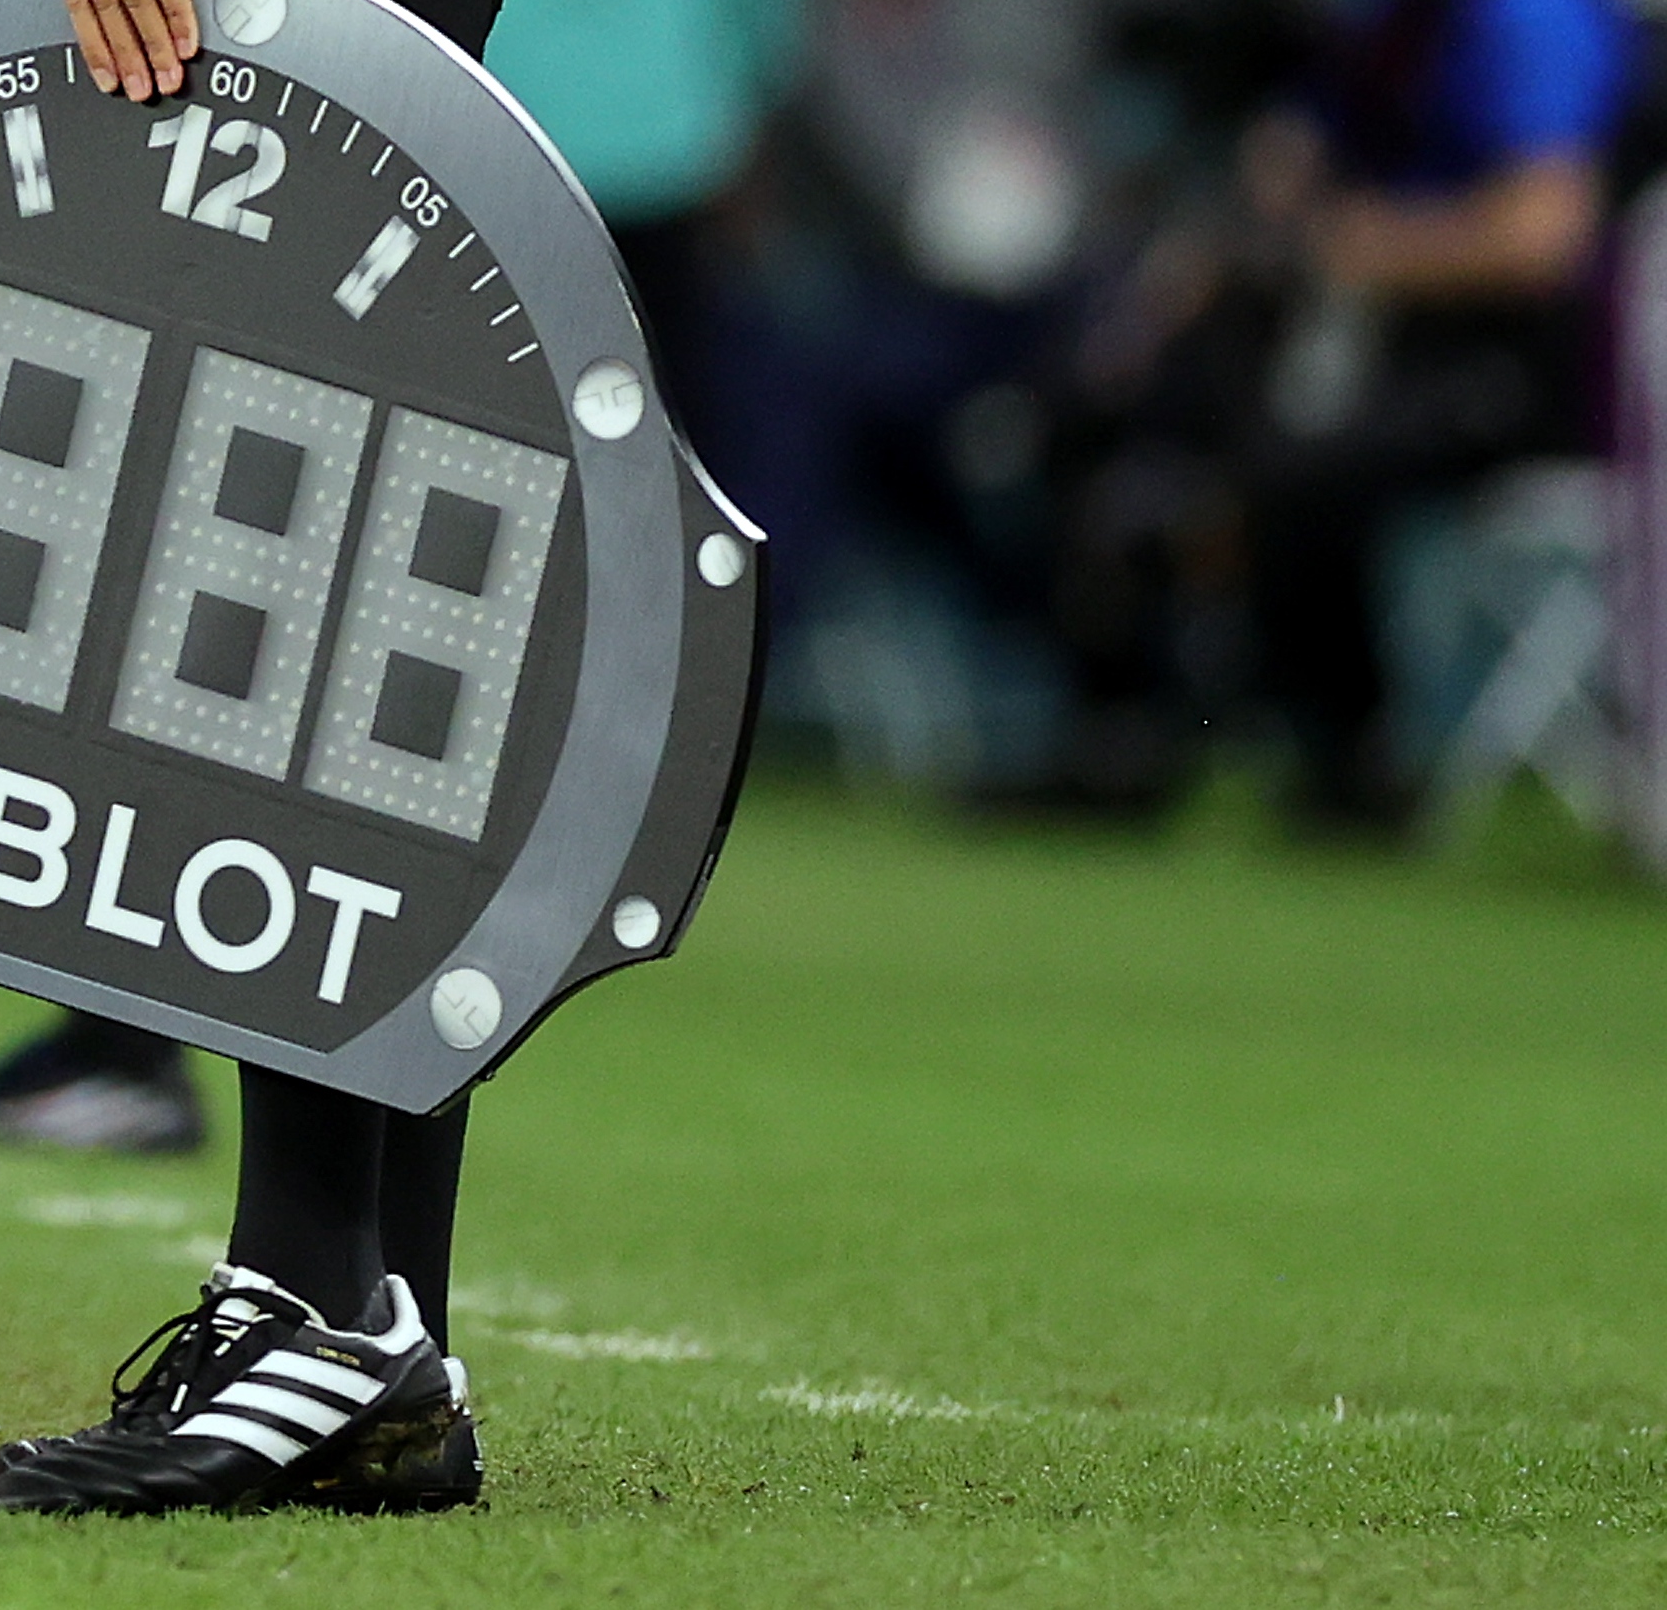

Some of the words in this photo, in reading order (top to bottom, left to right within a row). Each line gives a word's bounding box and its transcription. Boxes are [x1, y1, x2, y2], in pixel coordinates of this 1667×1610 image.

[147, 103, 288, 243] 12
[209, 60, 257, 104] 60
[399, 175, 449, 228] 05
